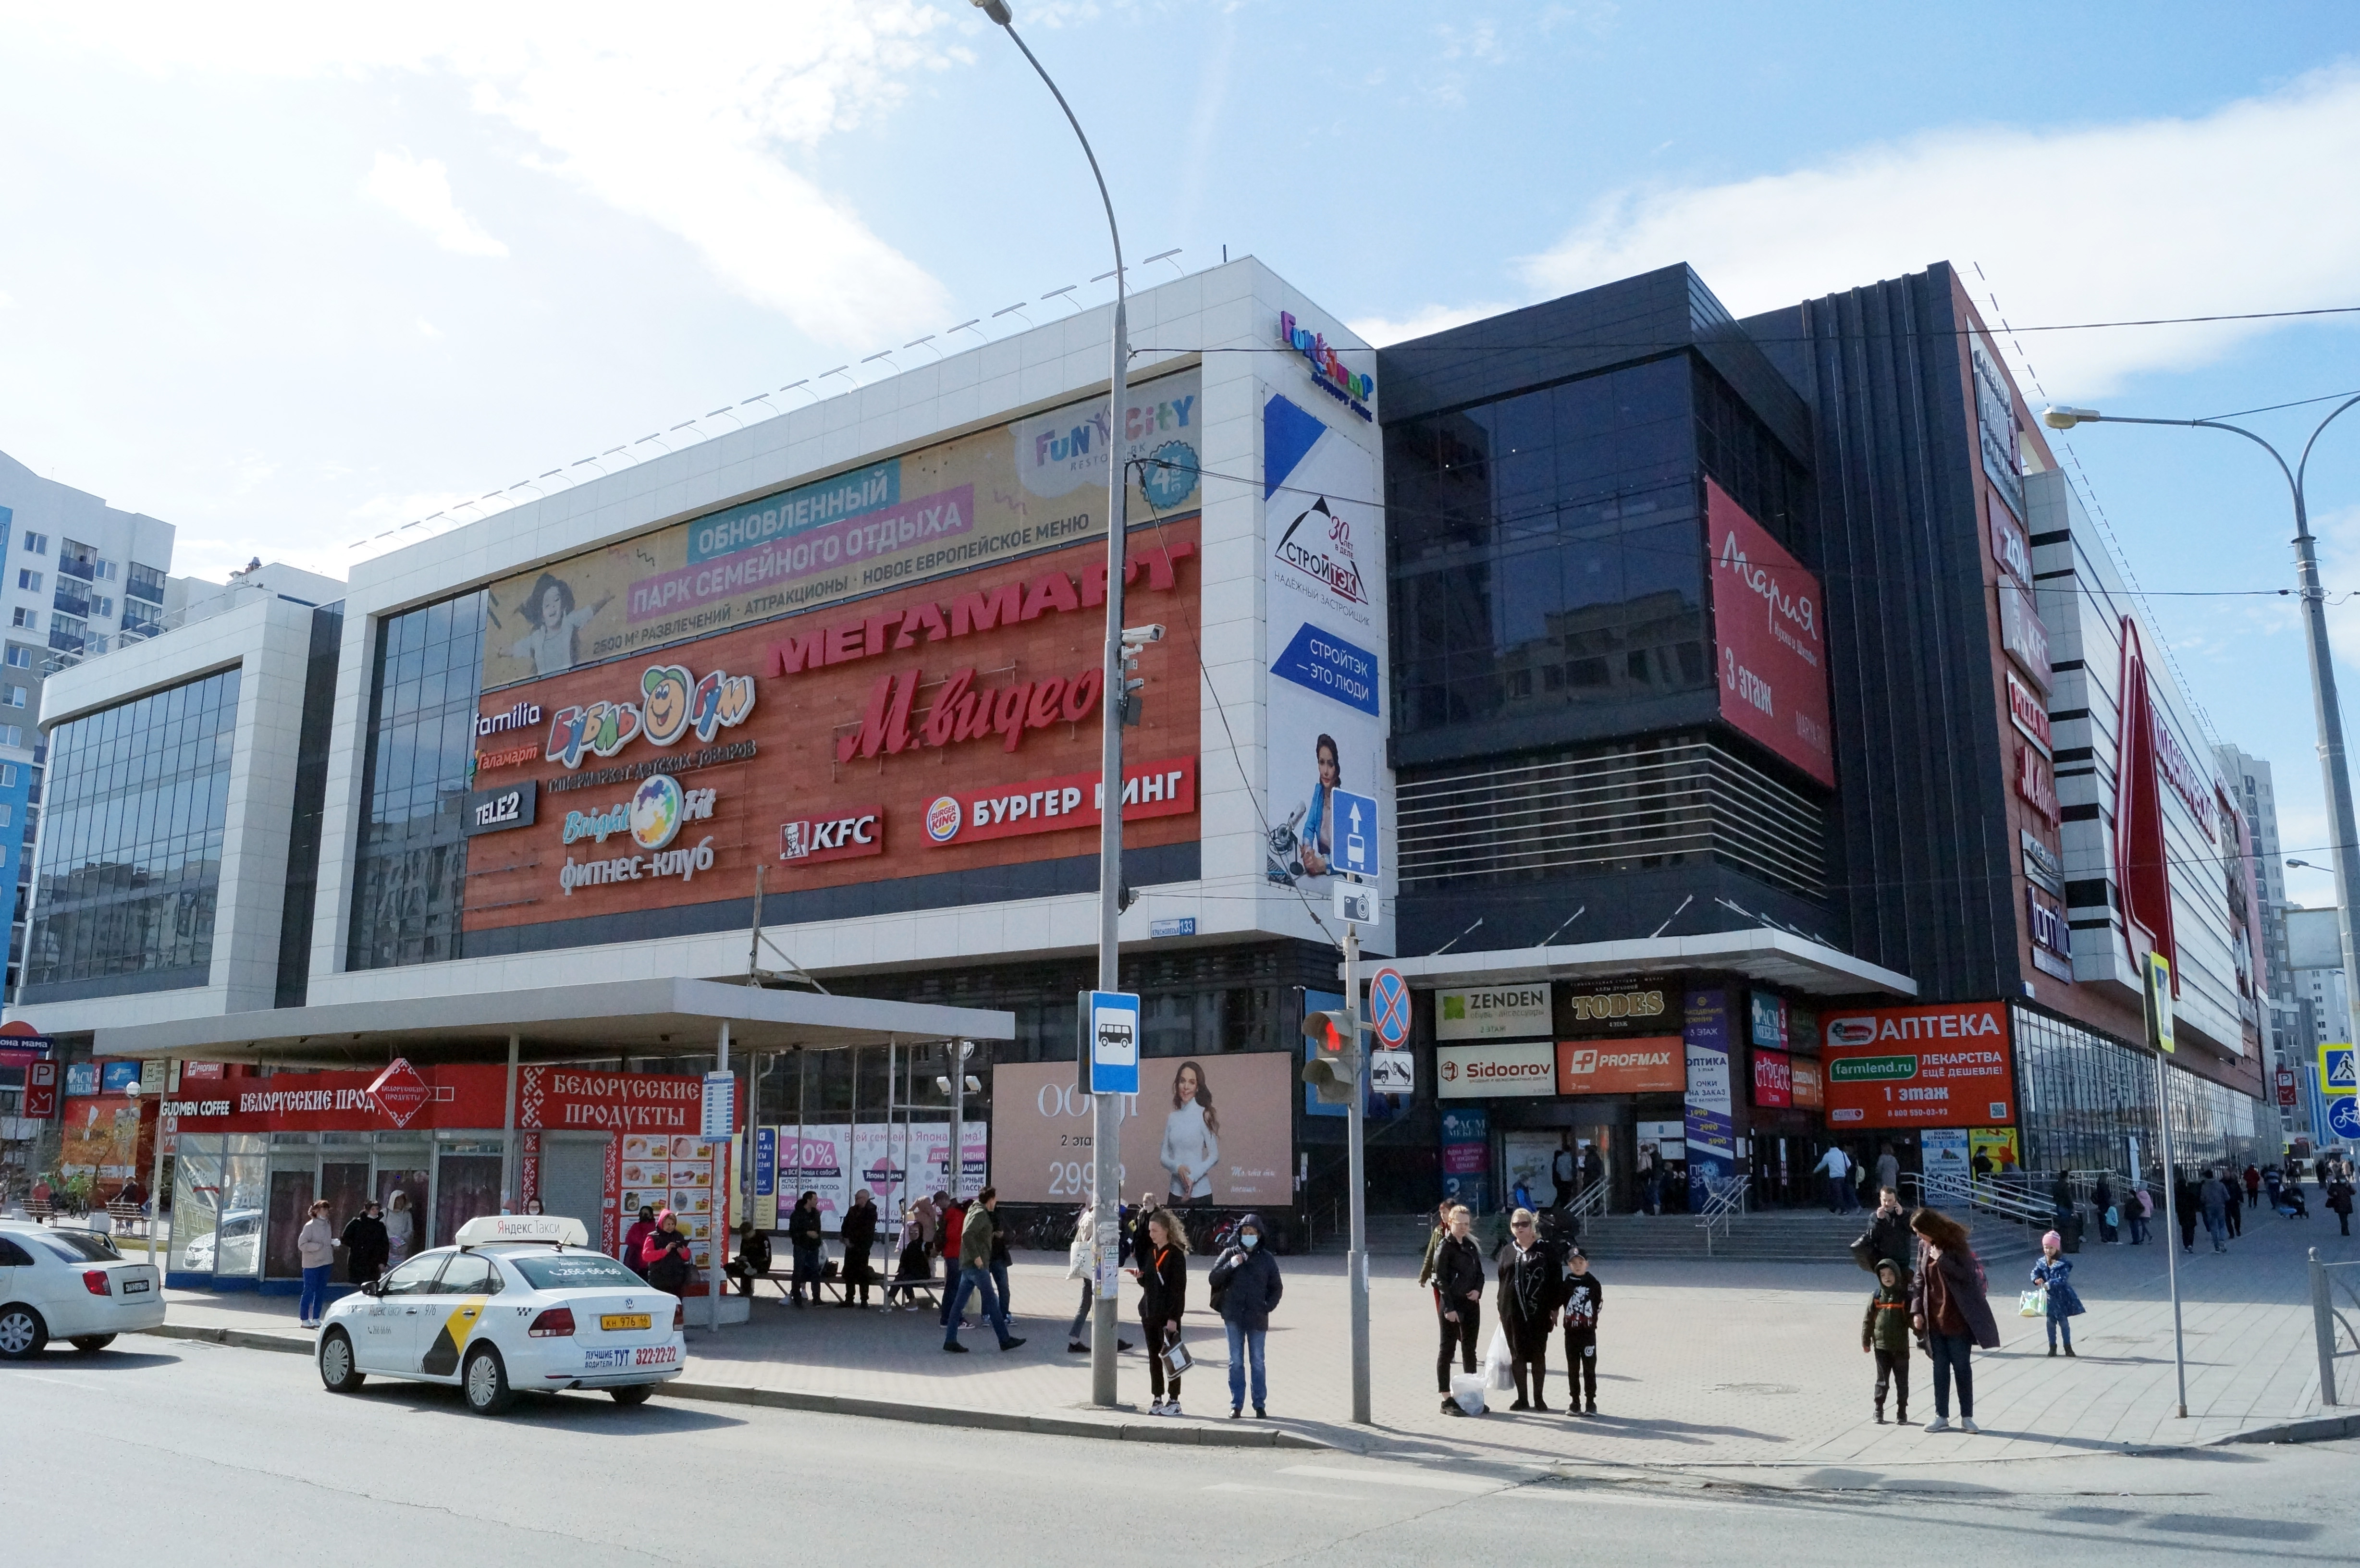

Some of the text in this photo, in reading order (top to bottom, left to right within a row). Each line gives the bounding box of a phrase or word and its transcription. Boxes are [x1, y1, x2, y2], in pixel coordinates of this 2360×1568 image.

[699, 470, 888, 554] ОБНОВЛЕННЫЙ
[1328, 515, 1350, 547] 30
[633, 501, 961, 616] ПАРК СЕМЕЙНОГО ОТДЫХА
[1286, 542, 1356, 595] СТРОЙТЭК
[593, 636, 623, 655] 2500
[641, 604, 731, 642] РАЗВЛЕЧЕНИЙ
[745, 576, 848, 615] АТТРАКЦИОНЫ
[863, 559, 912, 586] НОВОЕ
[916, 527, 1031, 572] ЕВРОПЕЙСКОЕ
[1036, 514, 1089, 542] МЕНЮ
[1275, 571, 1370, 625] НАДЁЖНЫЙ ЗАСТРОЙЩИК
[773, 542, 1195, 674] МЕГАМАРТ
[1310, 638, 1368, 678] СТРОЙТЭК
[1310, 662, 1369, 702] ЭТО ЛЮДИ
[1725, 646, 1774, 717] 3 этаж
[473, 701, 541, 737] familia
[476, 791, 519, 826] TELE2
[930, 805, 956, 822] BURGER
[973, 786, 1082, 827] БУРГЕР
[563, 788, 716, 845] Bright Fit
[931, 811, 957, 831] KING
[810, 815, 876, 852] KFC
[560, 836, 714, 896] фитнес-клуб
[1180, 919, 1193, 933] 133
[1470, 990, 1544, 1009] ZENDEN
[1572, 991, 1665, 1020] TODES
[1697, 1027, 1718, 1036] ЭТАЖ
[1880, 1013, 2001, 1041] АПТЕКА
[197, 1063, 220, 1072] PROFMAX
[1599, 1052, 1671, 1067] PROFMAX
[1685, 1057, 1727, 1066] ОПТИКА
[1922, 1051, 2002, 1066] ЛЕКАРСТВА
[1466, 1062, 1551, 1078] Sidoorov
[1835, 1062, 1912, 1075] farmlend.ru
[1922, 1066, 2003, 1078] ЕЩЁ ДЕШЕВЛЕ!
[385, 1093, 420, 1102] ПРОДУКТЫ
[553, 1074, 700, 1102] БЕЛОРУССКИЕ
[1884, 1087, 1949, 1102] 1 этаж
[161, 1101, 230, 1116] GUDMEN COFFEE
[240, 1089, 332, 1117] БЕЛОРУССКИЕ
[565, 1103, 686, 1130] ПРОДУКТЫ
[844, 1132, 867, 1142] Вей
[916, 1131, 948, 1142] Япона
[1061, 1134, 1094, 1147] 2 эта
[497, 1220, 560, 1235] Яндекс Такси
[368, 1303, 401, 1317] Яндекс Такси
[425, 1304, 437, 1316] 976
[620, 1317, 636, 1326] 976
[585, 1349, 613, 1360] ЛУЧШИЕ
[614, 1349, 630, 1367] ТУТ
[584, 1360, 613, 1369] ВОДИТЕЛИ
